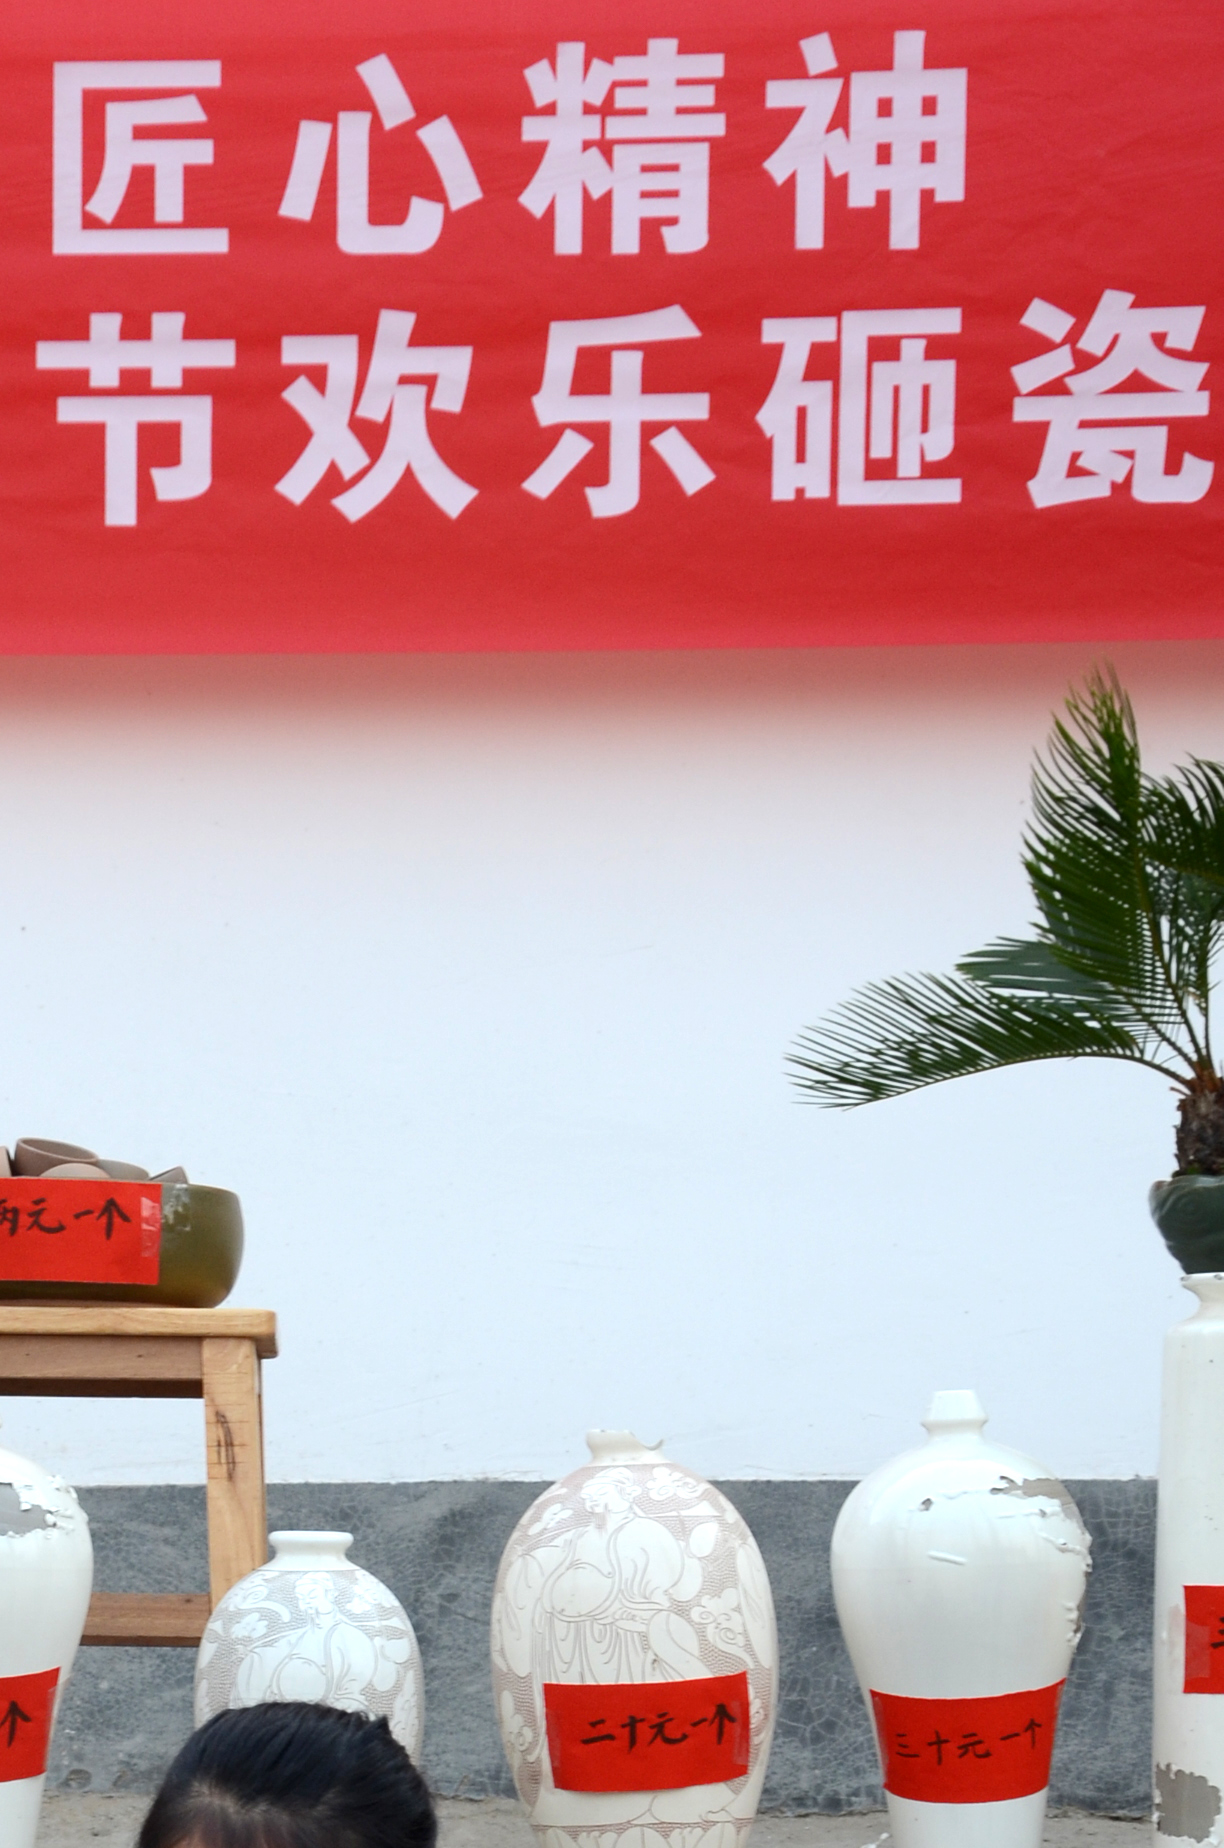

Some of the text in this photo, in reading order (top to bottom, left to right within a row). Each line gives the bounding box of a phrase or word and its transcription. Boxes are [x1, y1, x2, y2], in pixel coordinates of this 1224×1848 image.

[580, 1703, 737, 1752] 二十元一个
[895, 1718, 1043, 1766] 三十元一个
